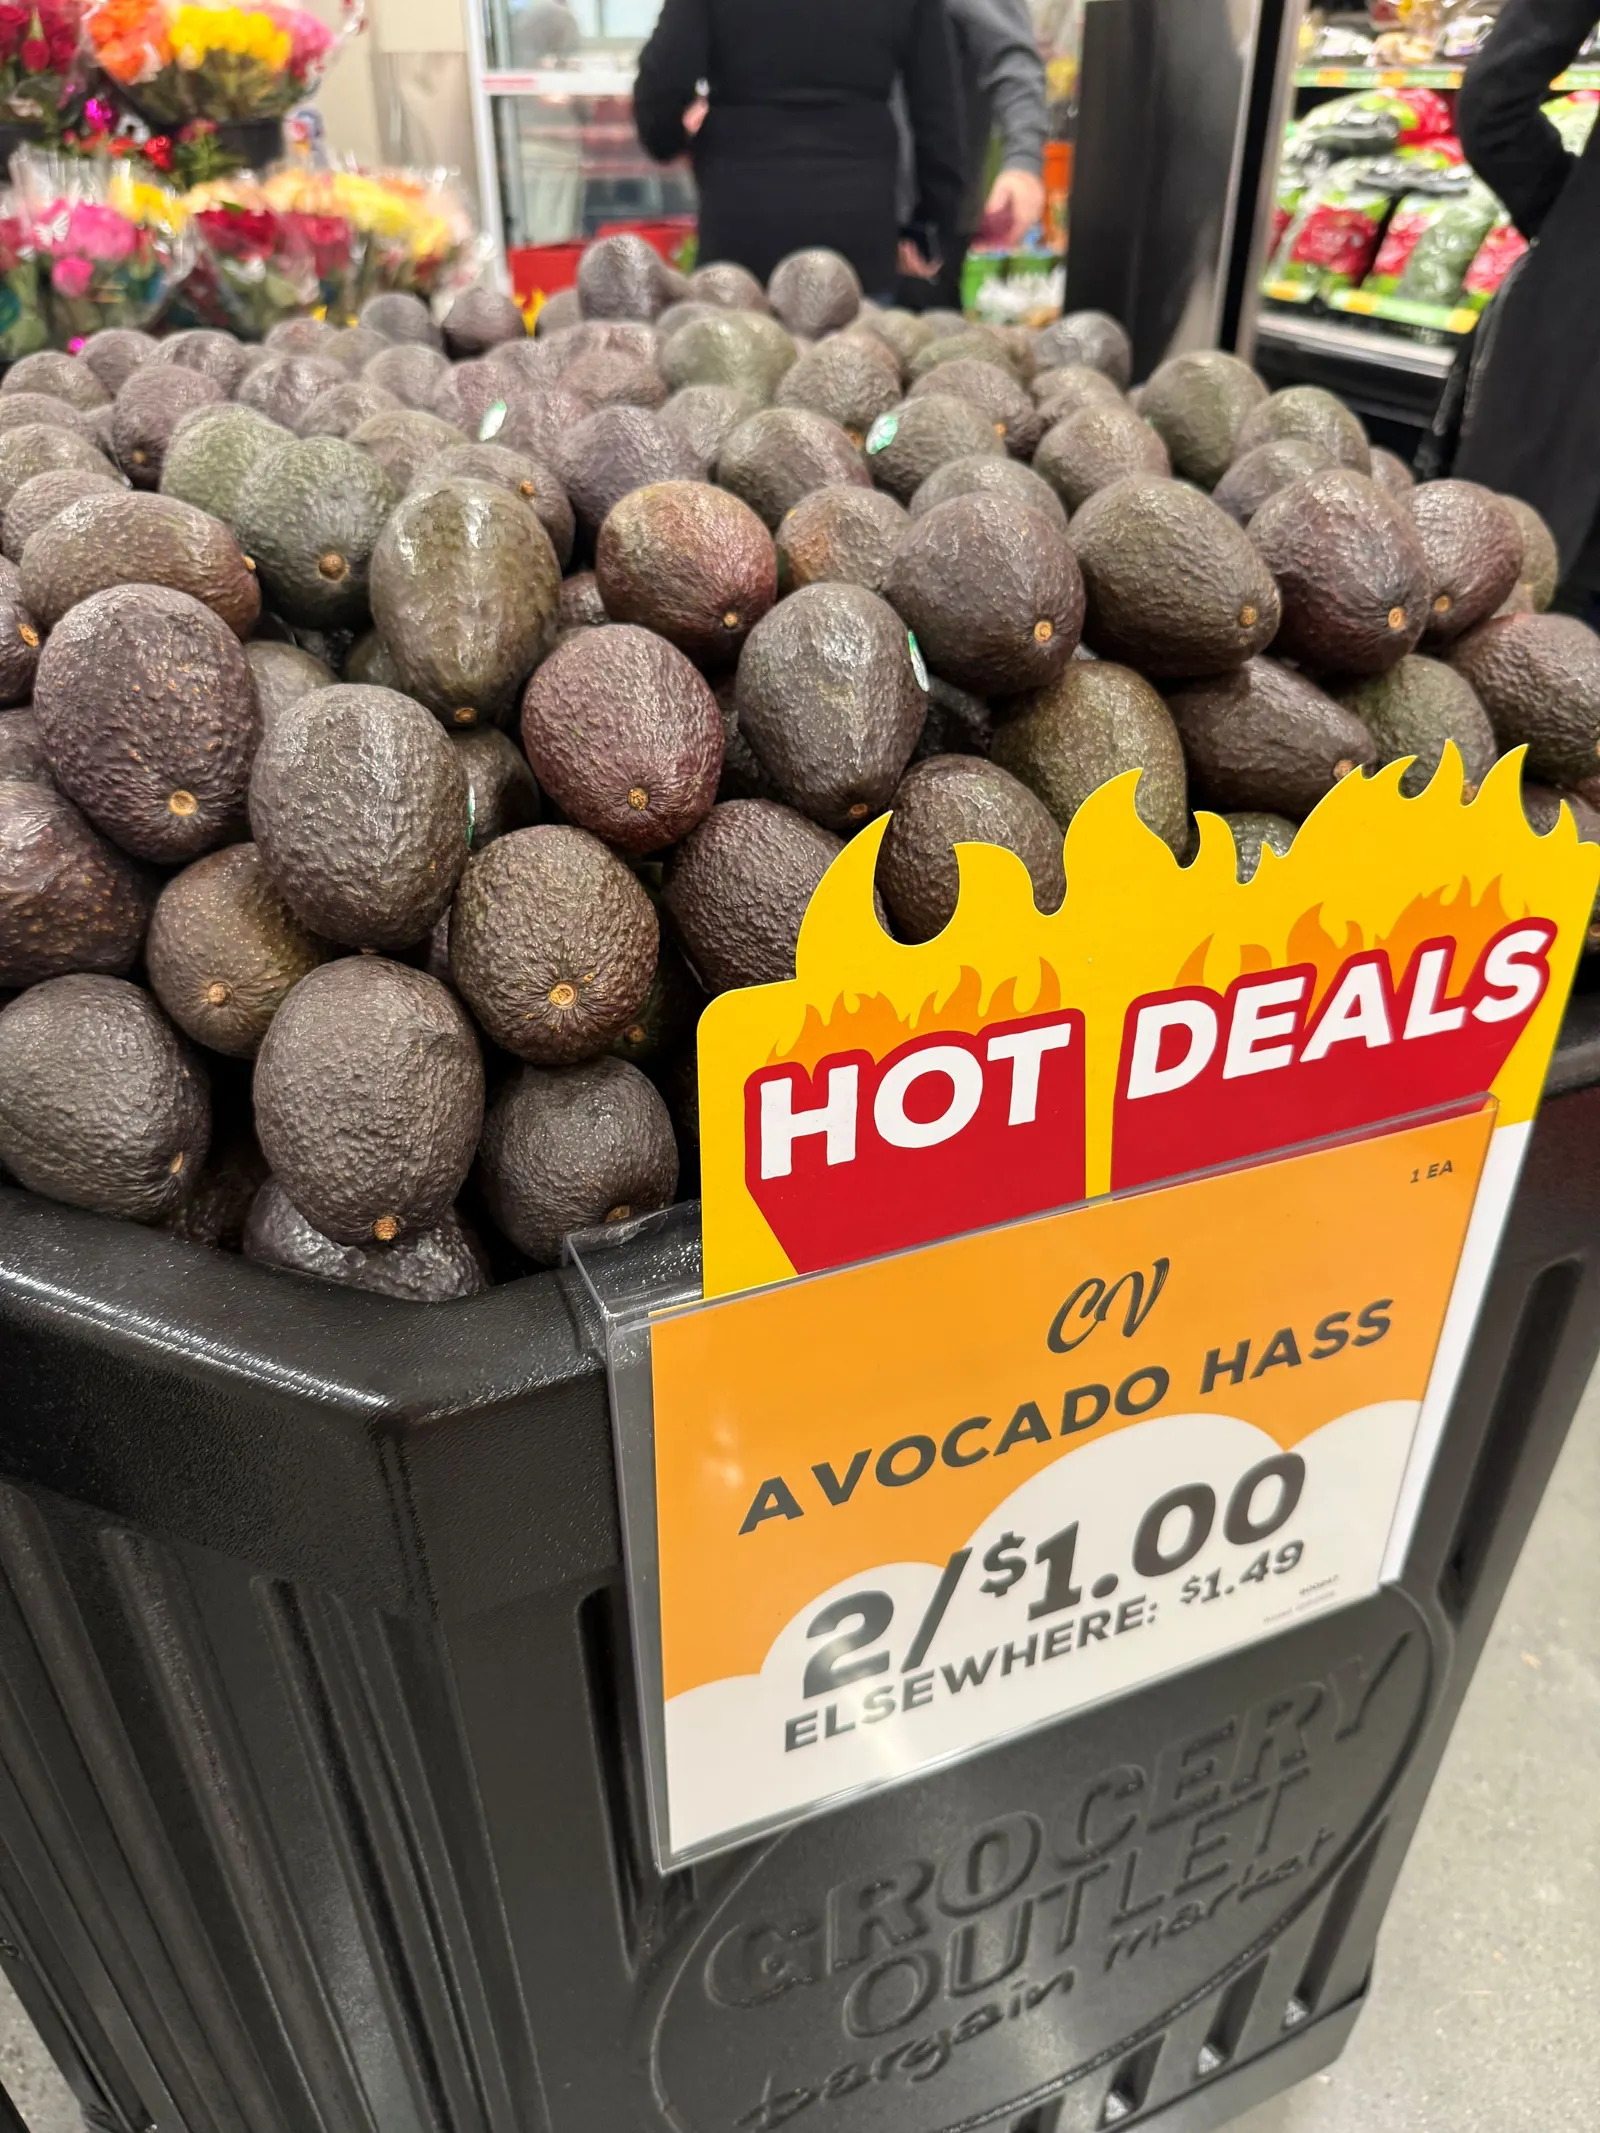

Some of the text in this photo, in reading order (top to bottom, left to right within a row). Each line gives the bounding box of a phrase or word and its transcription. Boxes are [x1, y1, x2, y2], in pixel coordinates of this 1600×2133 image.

[759, 929, 1549, 1180] HOT DEALS
[1409, 1159, 1453, 1184] 1 EA
[738, 1298, 1394, 1536] AVOCADO HASS
[783, 1539, 1305, 1753] ELSEWHERE: $1.49
[803, 1452, 1307, 1699] 2/$1.00
[704, 1630, 1412, 2008] GROCERY
[842, 1763, 1310, 2040] OUTLET
